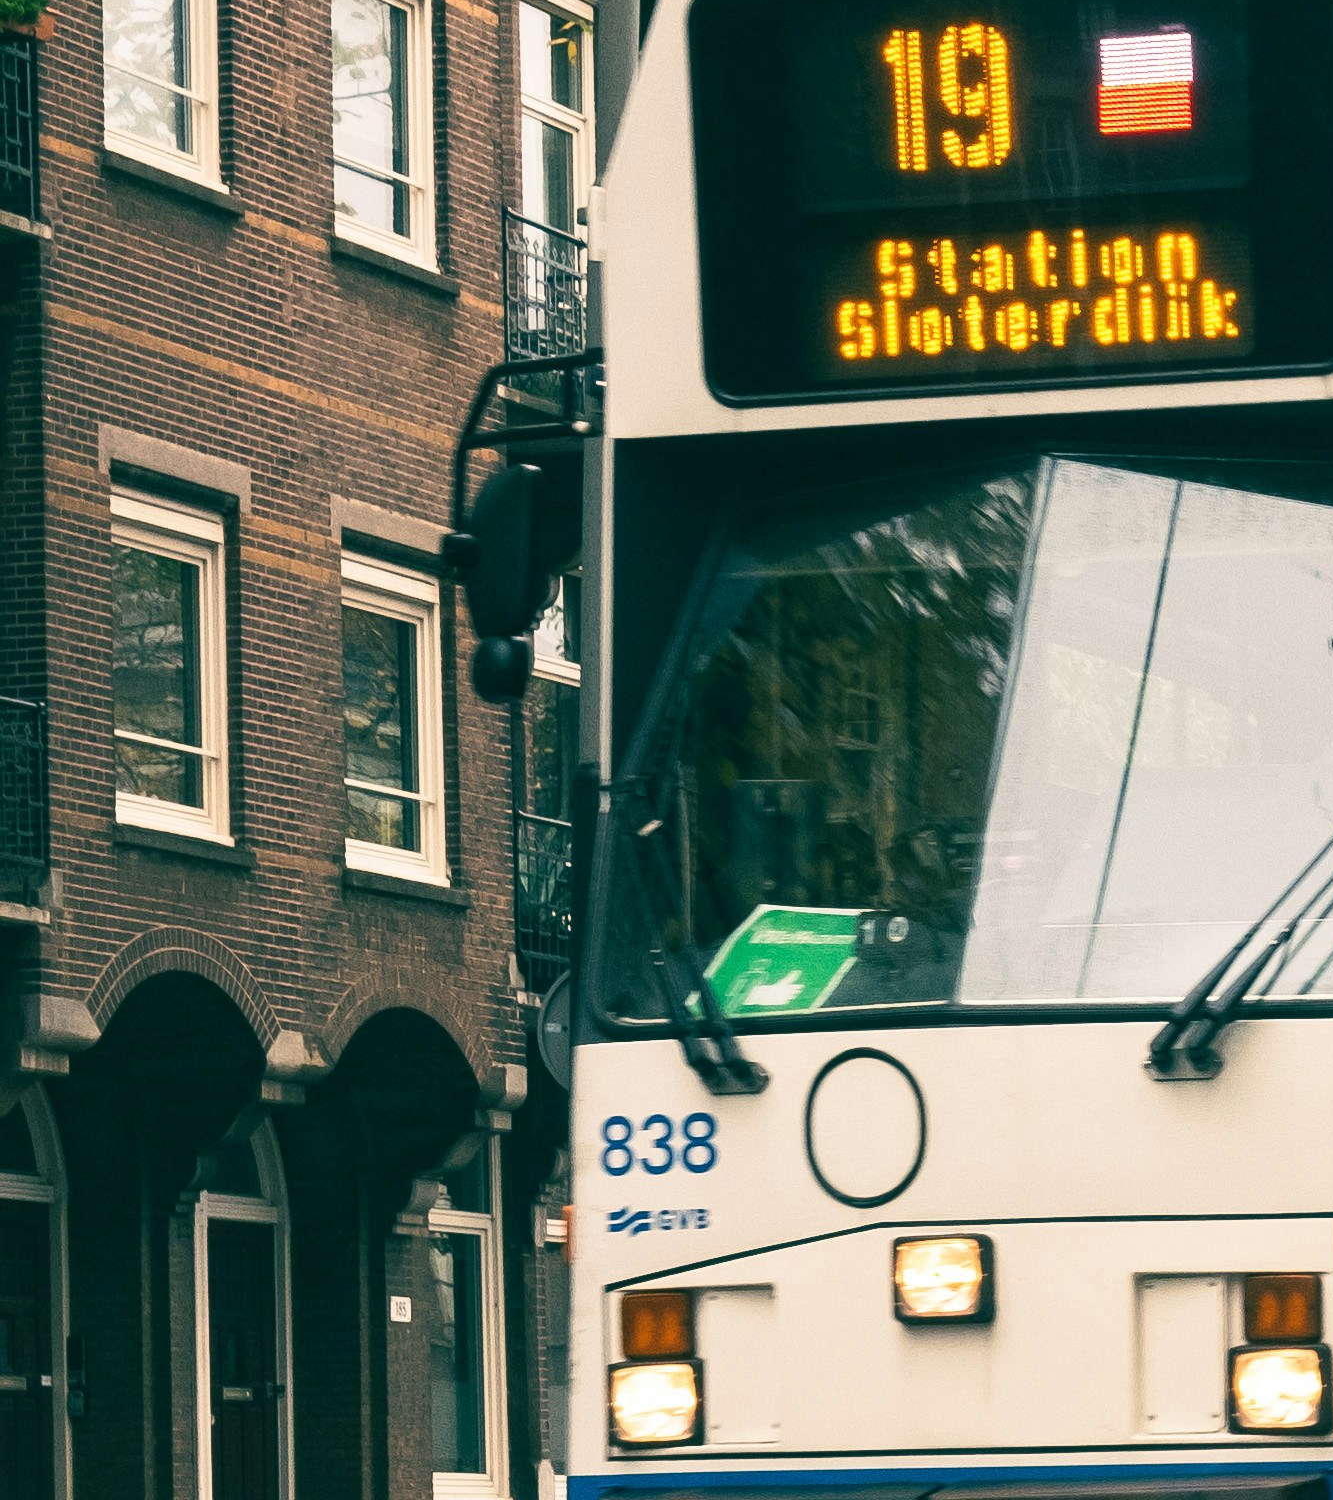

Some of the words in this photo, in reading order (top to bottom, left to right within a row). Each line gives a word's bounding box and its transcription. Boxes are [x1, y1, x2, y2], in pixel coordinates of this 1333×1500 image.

[883, 23, 1011, 171] 19
[877, 229, 1196, 297] Station
[600, 1111, 720, 1177] 838
